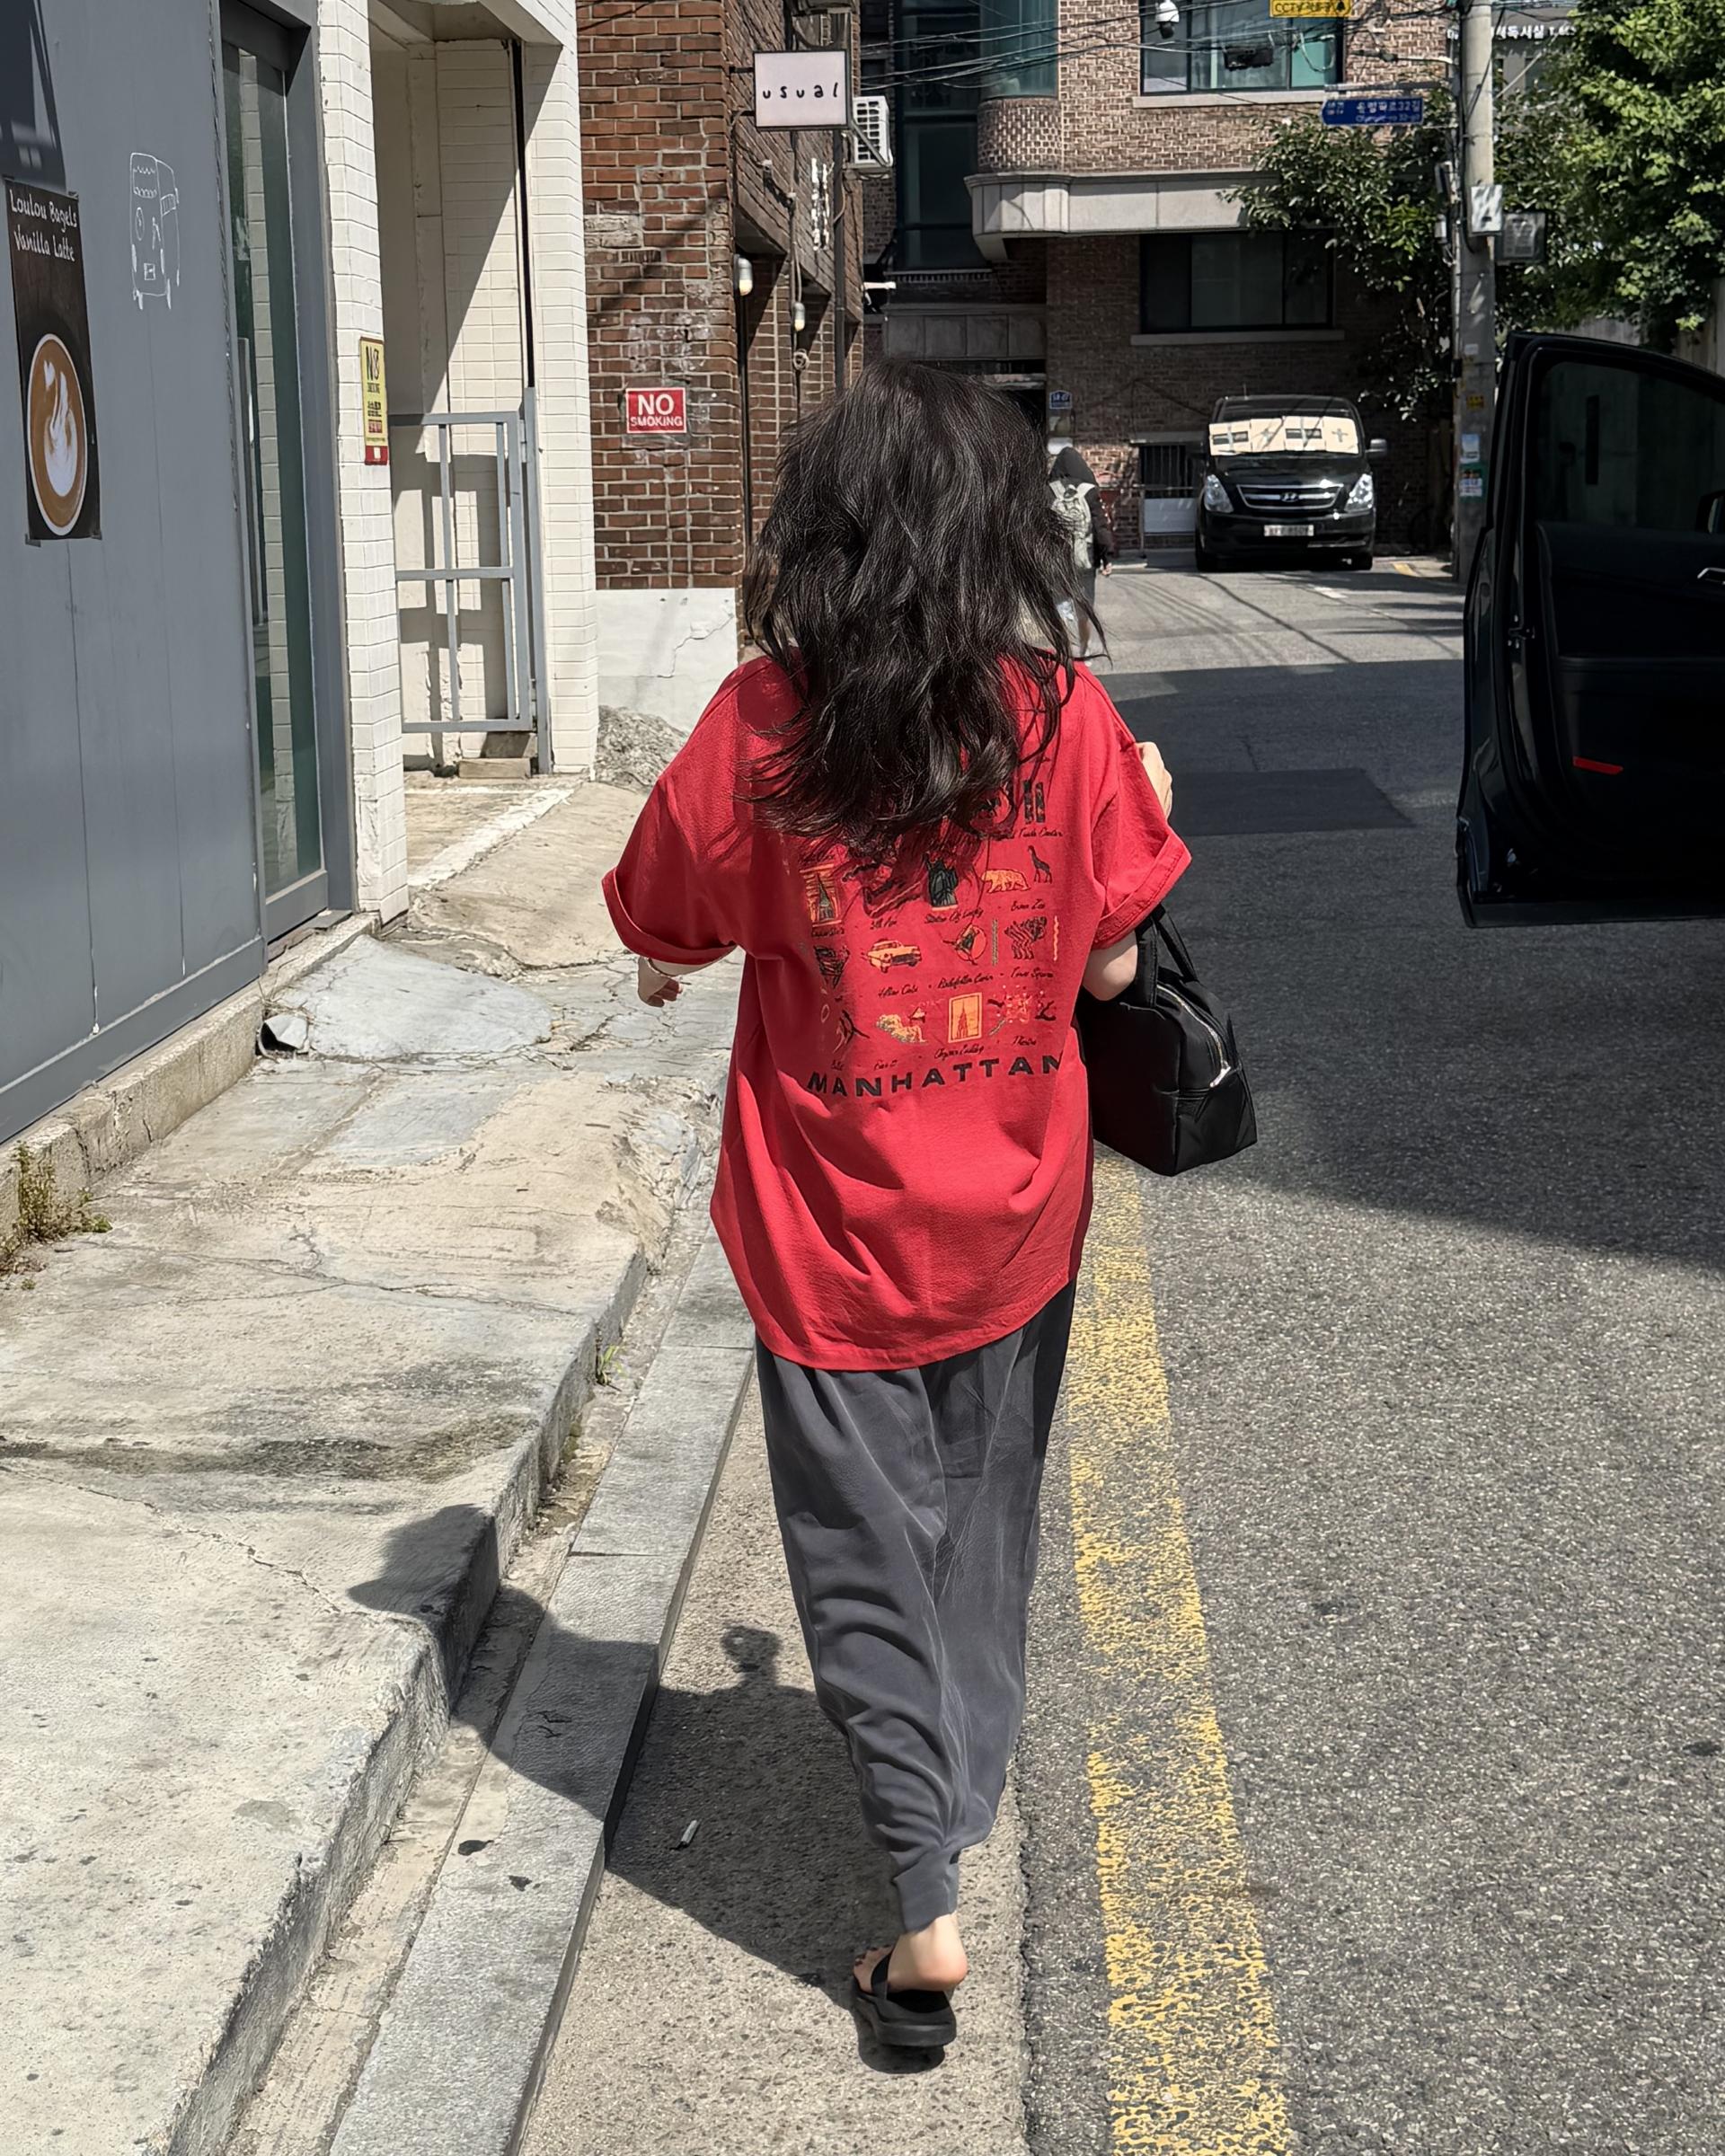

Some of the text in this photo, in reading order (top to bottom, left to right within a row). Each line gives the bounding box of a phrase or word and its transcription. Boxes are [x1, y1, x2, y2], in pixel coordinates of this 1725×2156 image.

[762, 82, 839, 99] usual
[9, 189, 78, 233] Loulou Bagels
[13, 224, 75, 262] Vanilla Latte
[637, 393, 675, 416] NO
[630, 416, 683, 427] SMOKING
[807, 1050, 1064, 1097] MANHATTAN
